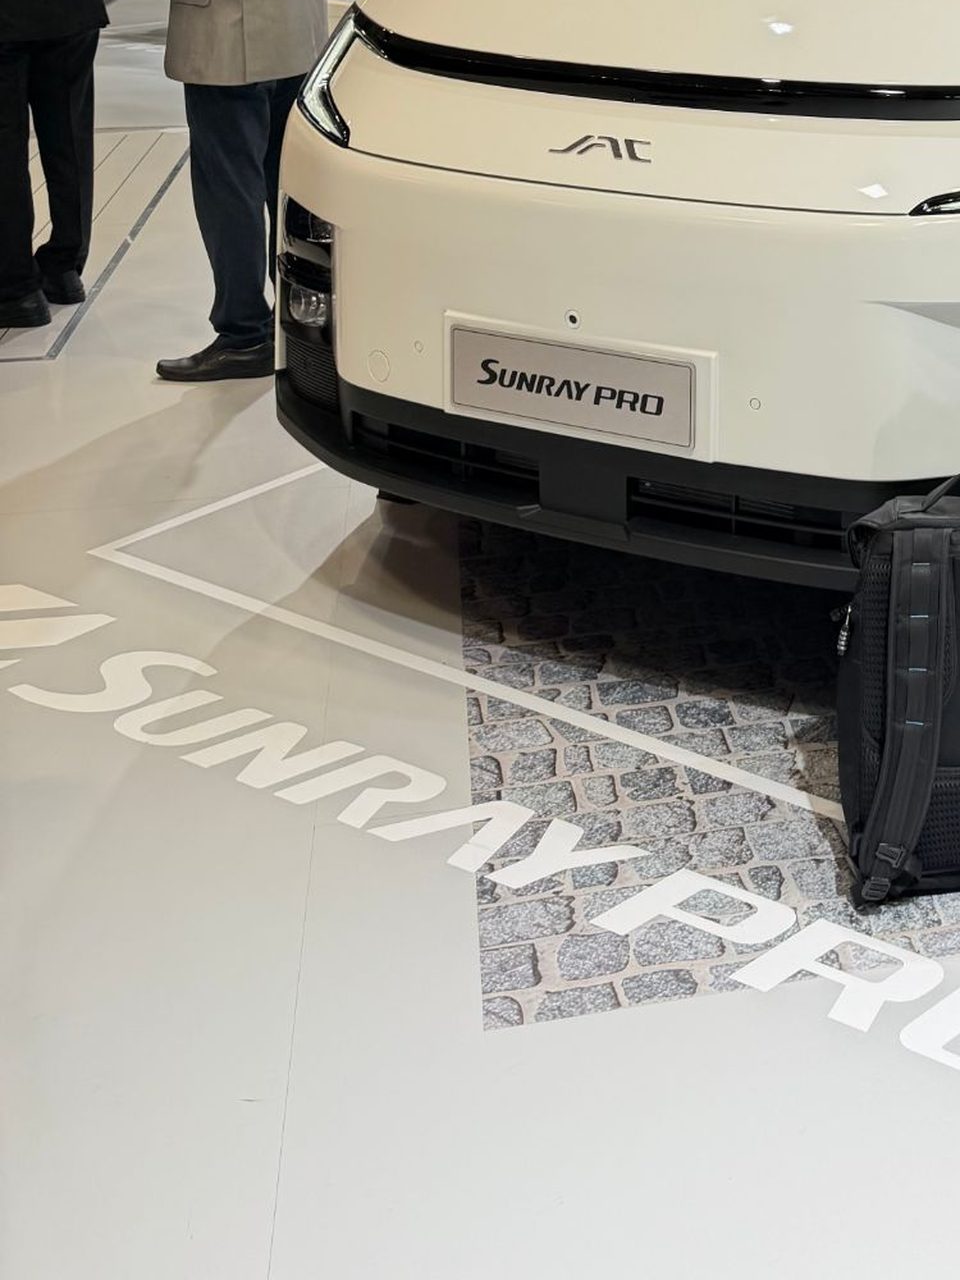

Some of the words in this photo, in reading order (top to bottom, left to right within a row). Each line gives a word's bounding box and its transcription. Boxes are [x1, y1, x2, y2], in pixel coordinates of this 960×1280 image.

[477, 358, 591, 401] SUNRAY
[593, 386, 664, 416] PRO
[7, 651, 648, 889] SUNRAY
